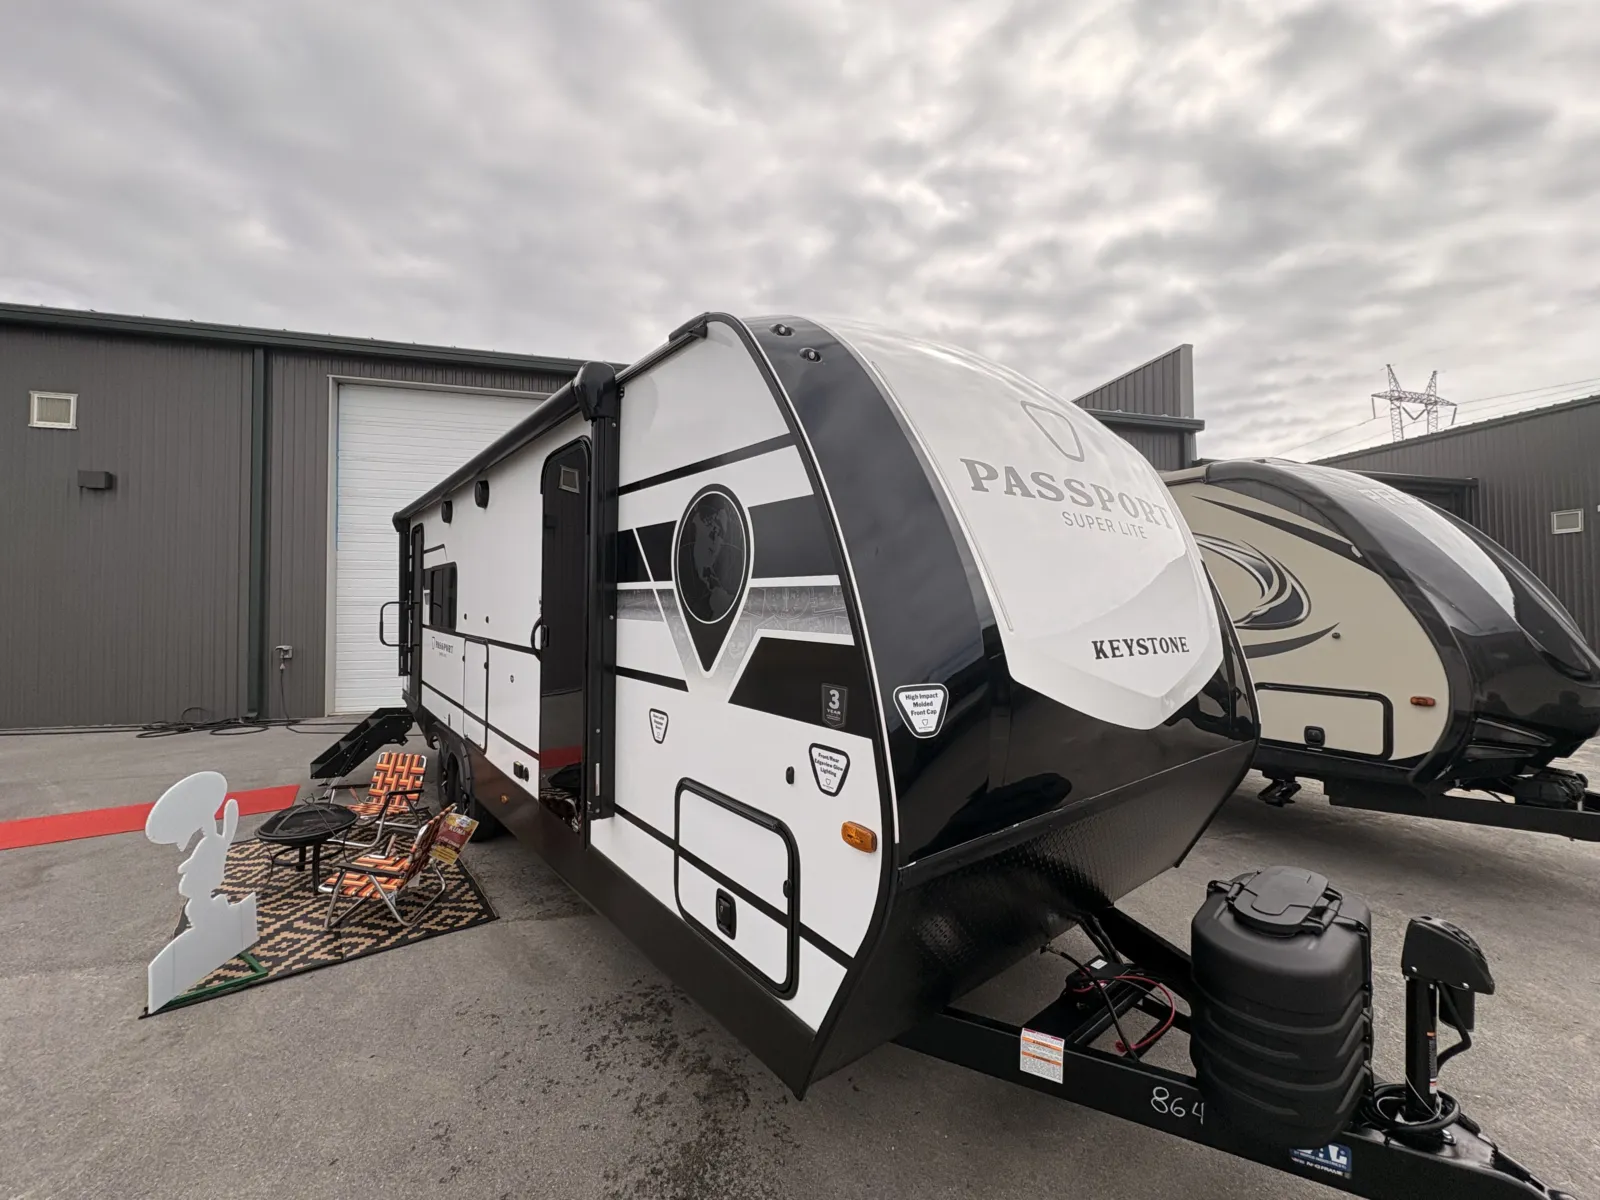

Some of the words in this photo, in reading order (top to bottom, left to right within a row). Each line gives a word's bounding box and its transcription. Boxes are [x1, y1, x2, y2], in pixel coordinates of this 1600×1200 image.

[960, 458, 1173, 530] PASSPORT
[1061, 511, 1116, 533] SUPER
[1118, 521, 1148, 539] LITE
[1091, 637, 1190, 660] KEYSTONE
[829, 689, 839, 709] 3
[919, 692, 938, 700] Impact
[910, 709, 926, 717] Front
[820, 766, 837, 777] Lighting
[1151, 1086, 1204, 1125] 864
